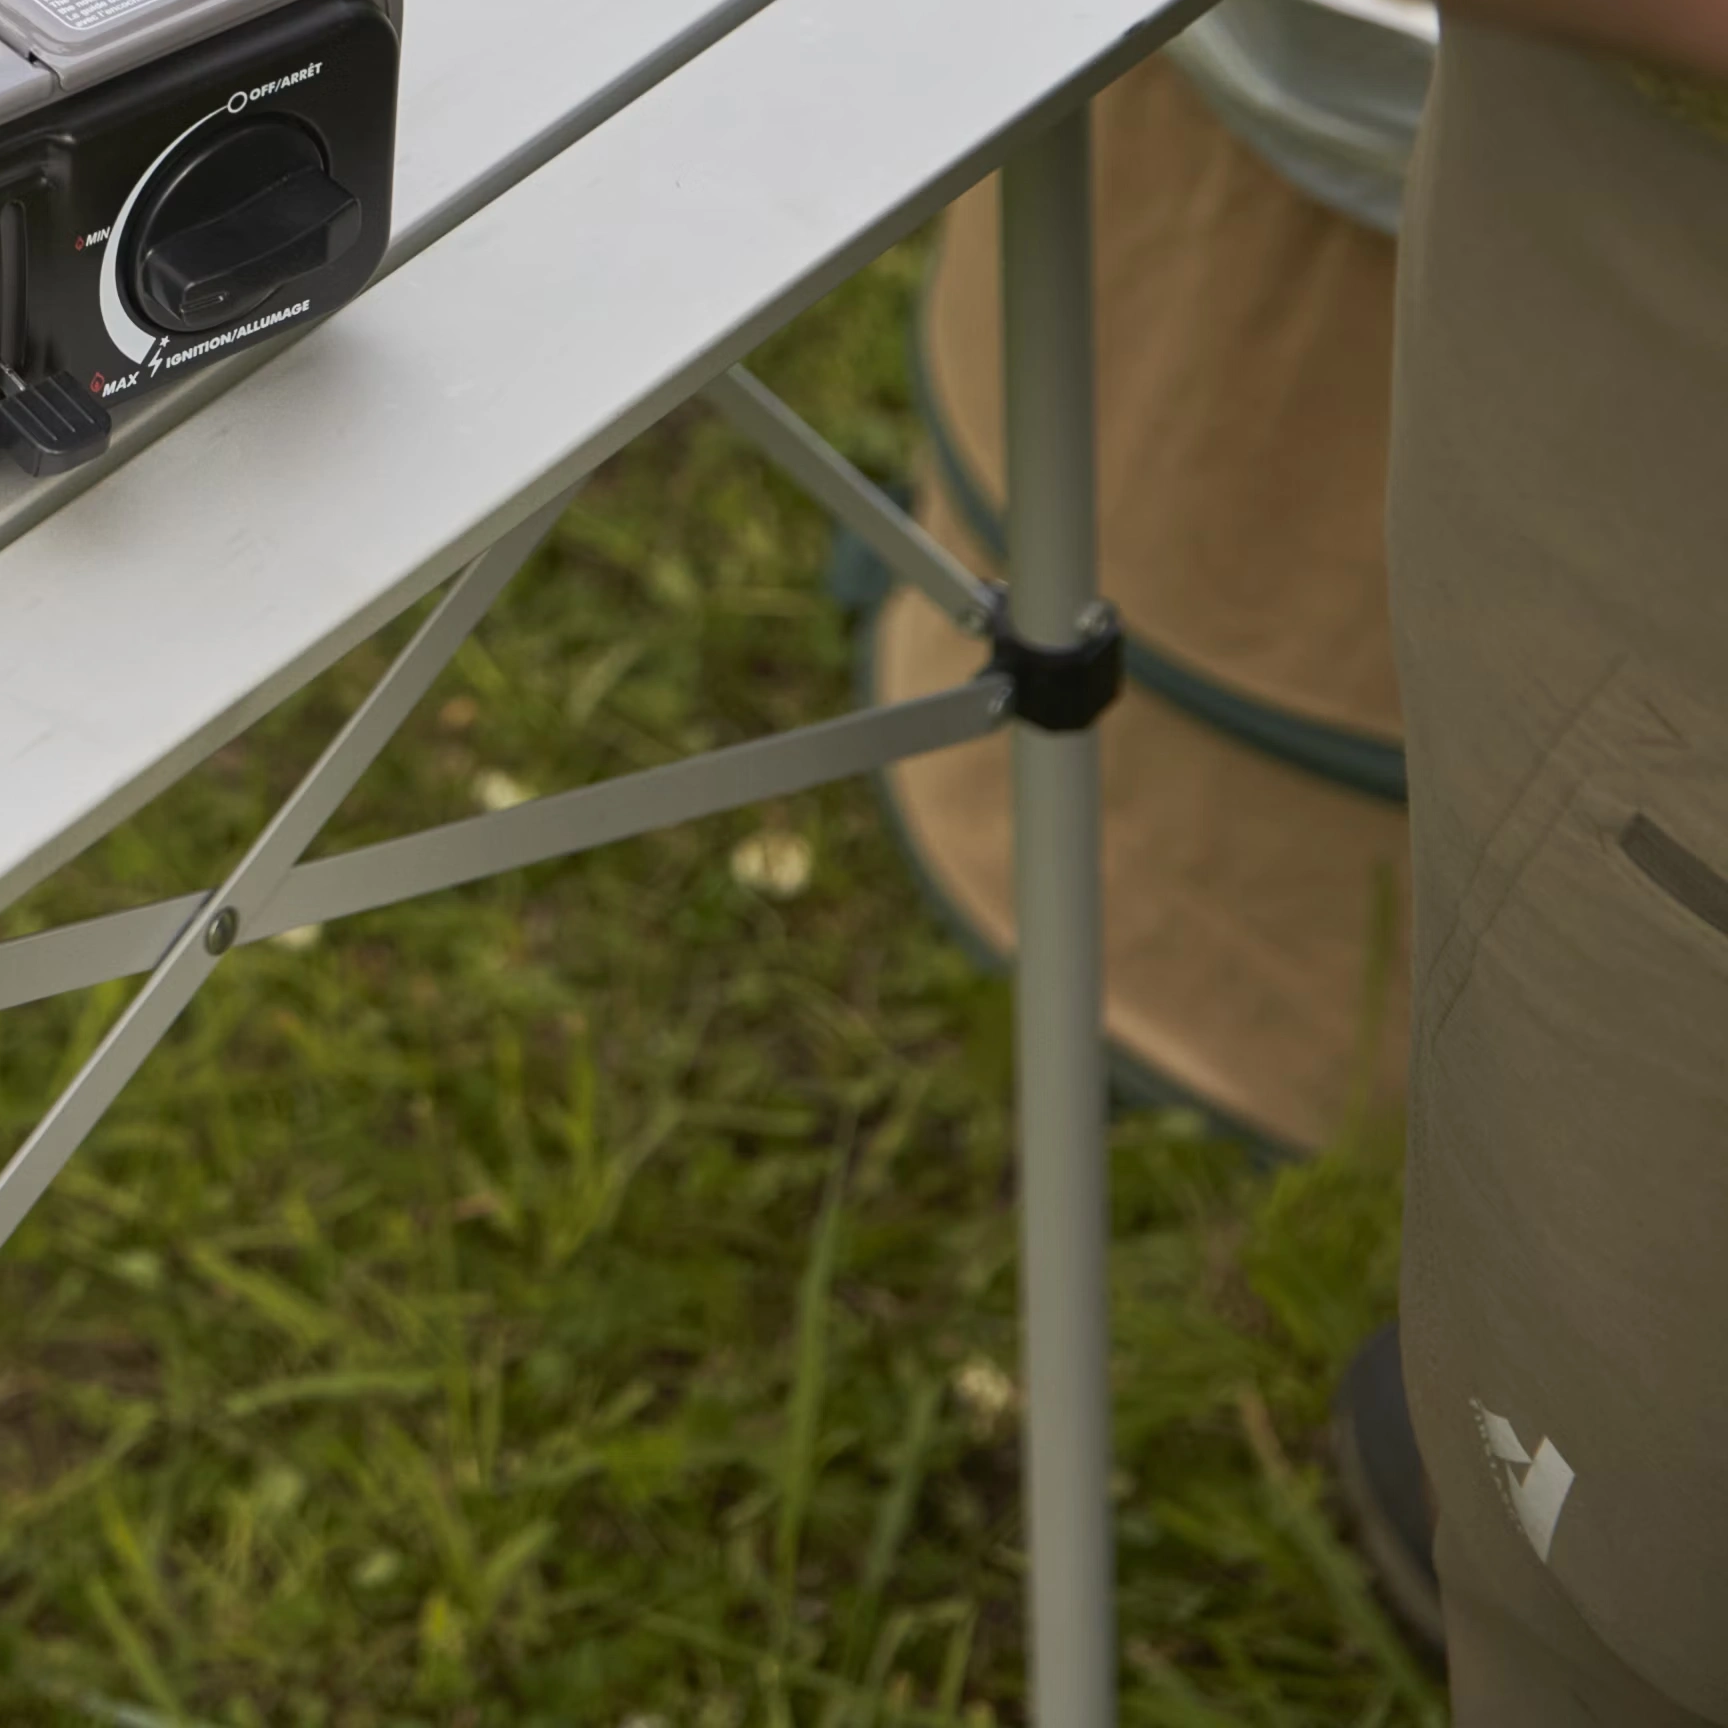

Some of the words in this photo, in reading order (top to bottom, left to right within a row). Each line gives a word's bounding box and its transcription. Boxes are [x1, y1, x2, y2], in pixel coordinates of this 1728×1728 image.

[249, 62, 323, 101] OFF/ARRÊT
[85, 226, 111, 247] MIN
[165, 299, 311, 369] IGNITION/ALLUMAGE
[101, 371, 141, 398] MAX
